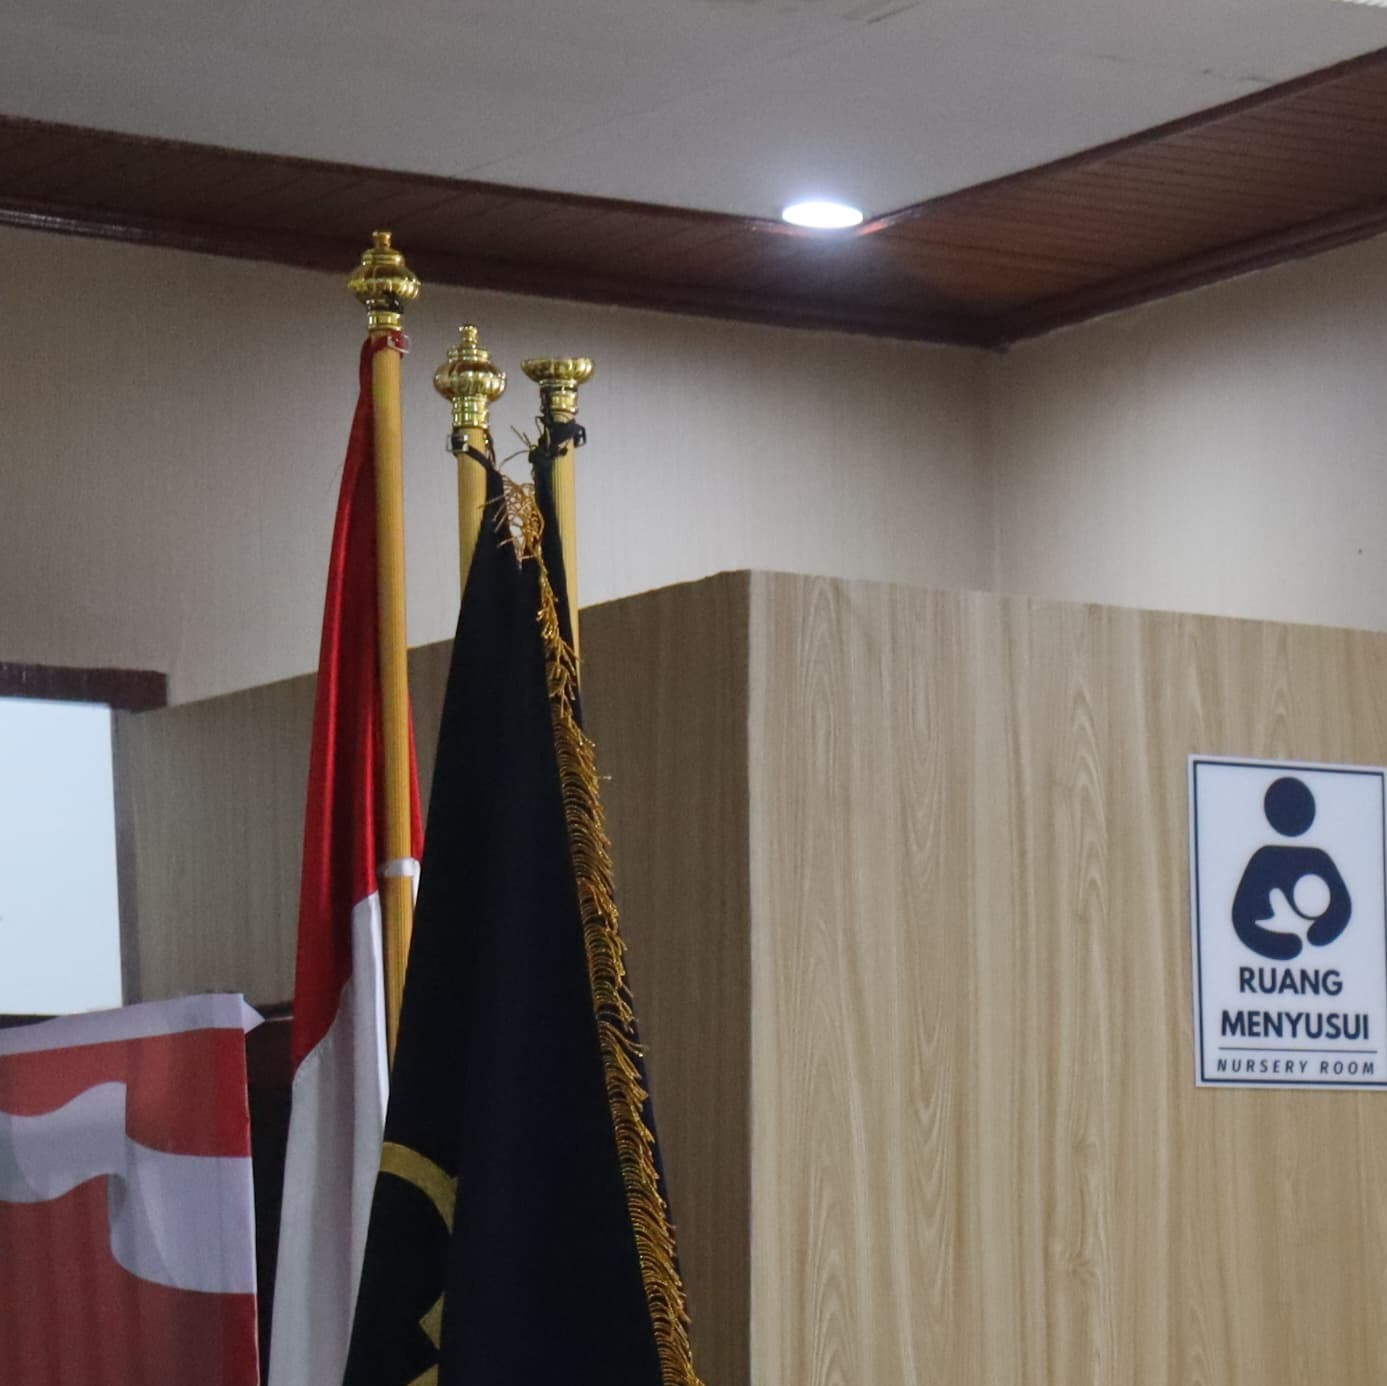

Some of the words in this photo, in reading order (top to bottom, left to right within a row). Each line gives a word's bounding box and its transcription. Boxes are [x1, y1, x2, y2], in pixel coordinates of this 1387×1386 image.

[1239, 967, 1343, 996] RUANG
[1221, 1010, 1369, 1040] MENYUSUI
[1217, 1060, 1308, 1074] NURSERY
[1320, 1061, 1374, 1075] ROOM
